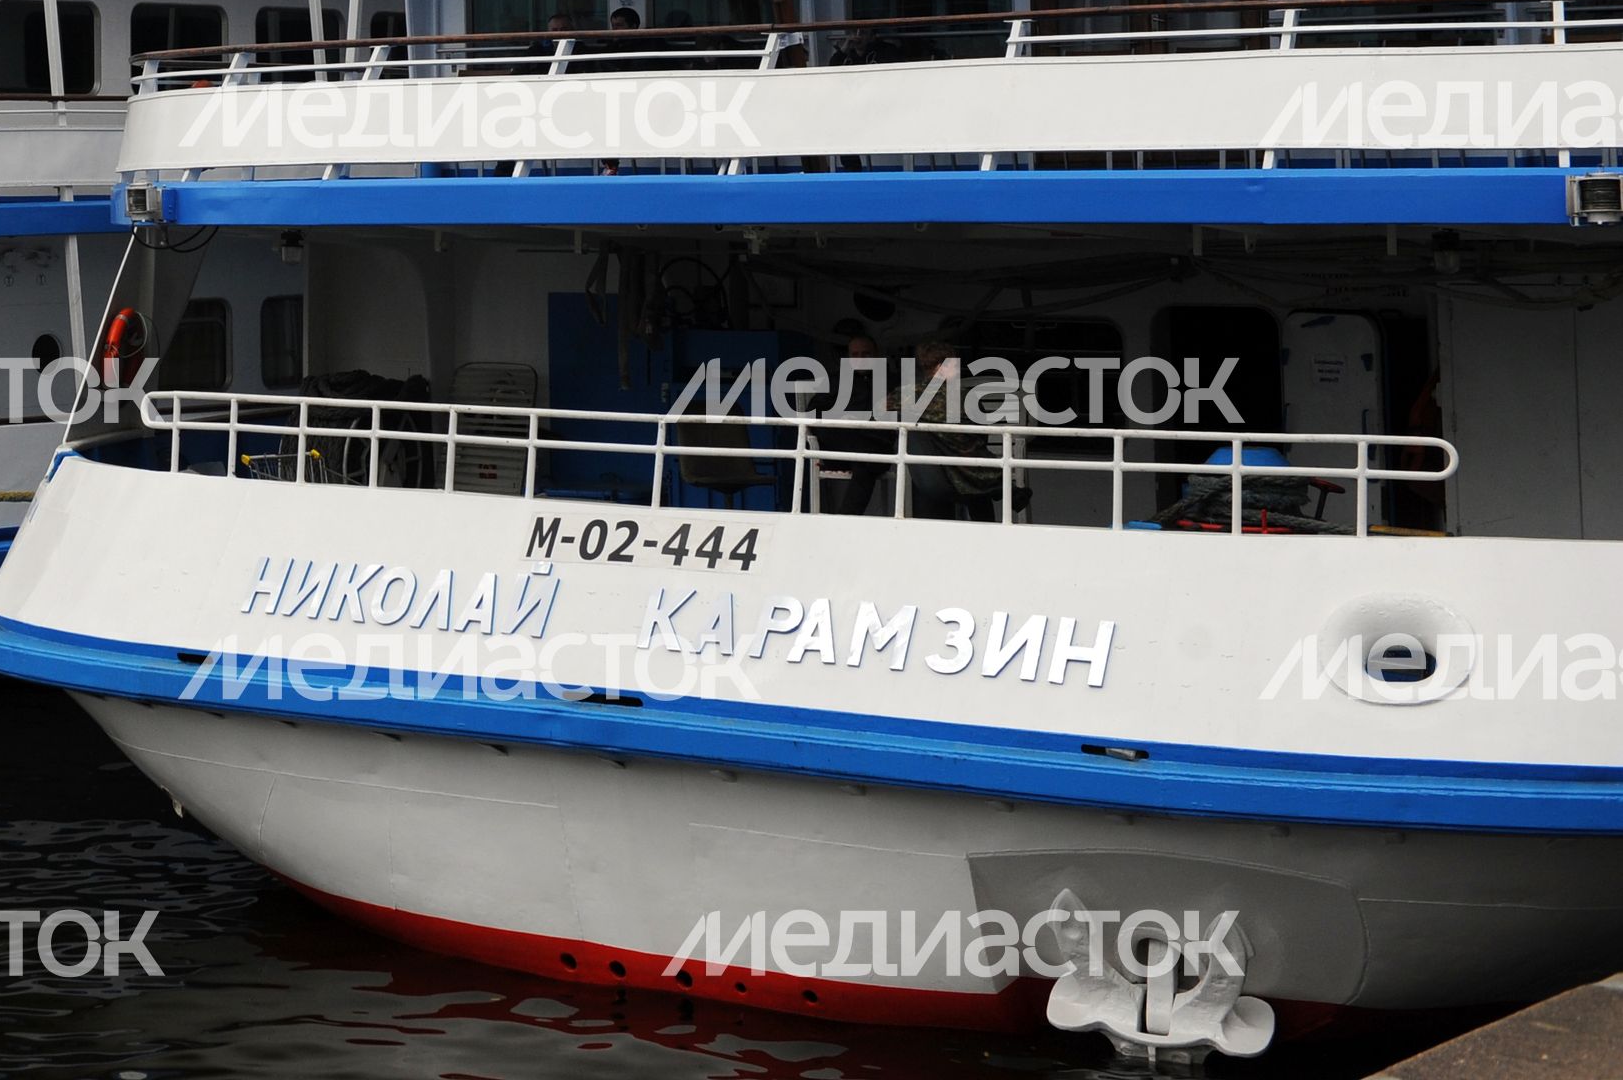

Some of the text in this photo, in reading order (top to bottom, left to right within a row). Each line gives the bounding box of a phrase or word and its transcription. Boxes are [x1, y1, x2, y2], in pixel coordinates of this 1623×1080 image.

[526, 516, 760, 571] М-02-444
[240, 556, 1117, 689] НИКОЛАЙ КАРАМЗИН
